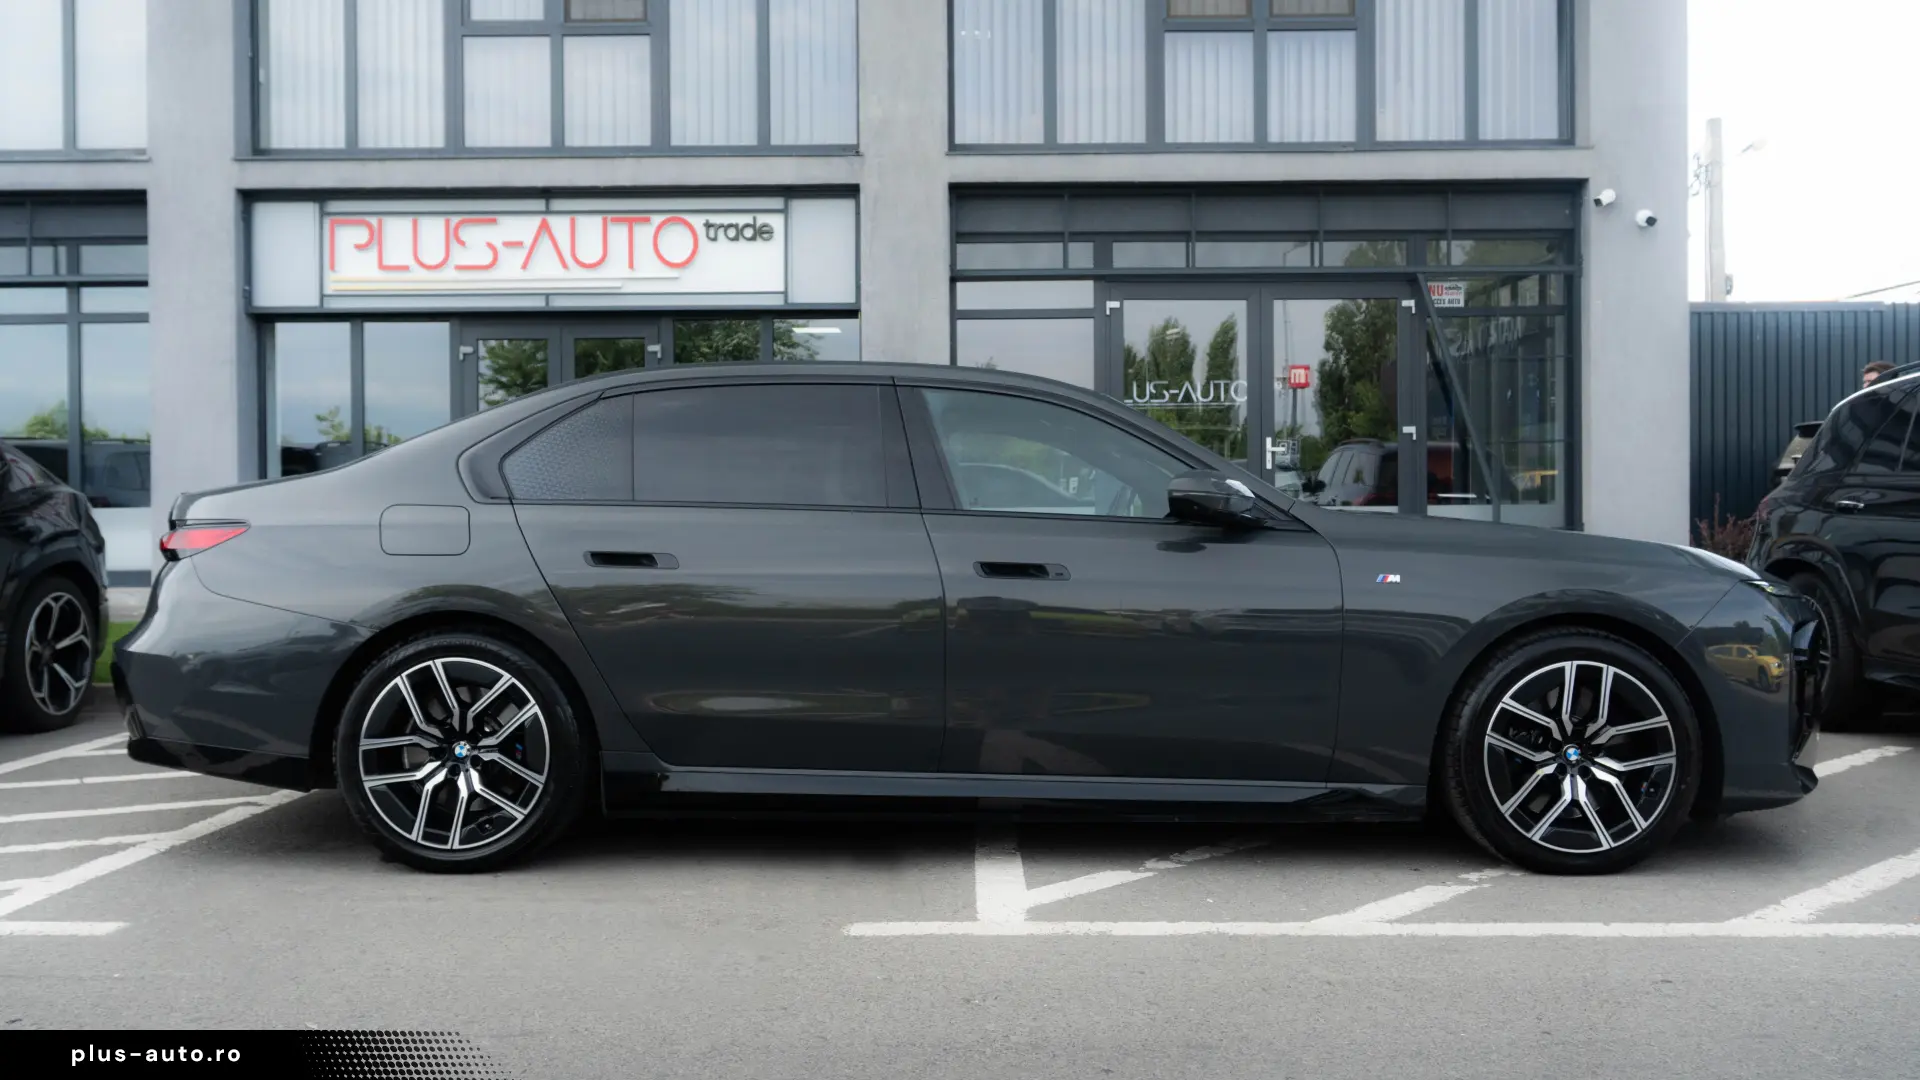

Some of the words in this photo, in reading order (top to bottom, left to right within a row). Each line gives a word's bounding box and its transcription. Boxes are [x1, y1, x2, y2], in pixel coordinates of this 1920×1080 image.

[329, 216, 699, 271] PLUS-AUTO
[703, 216, 774, 242] trade
[1428, 284, 1444, 296] NU
